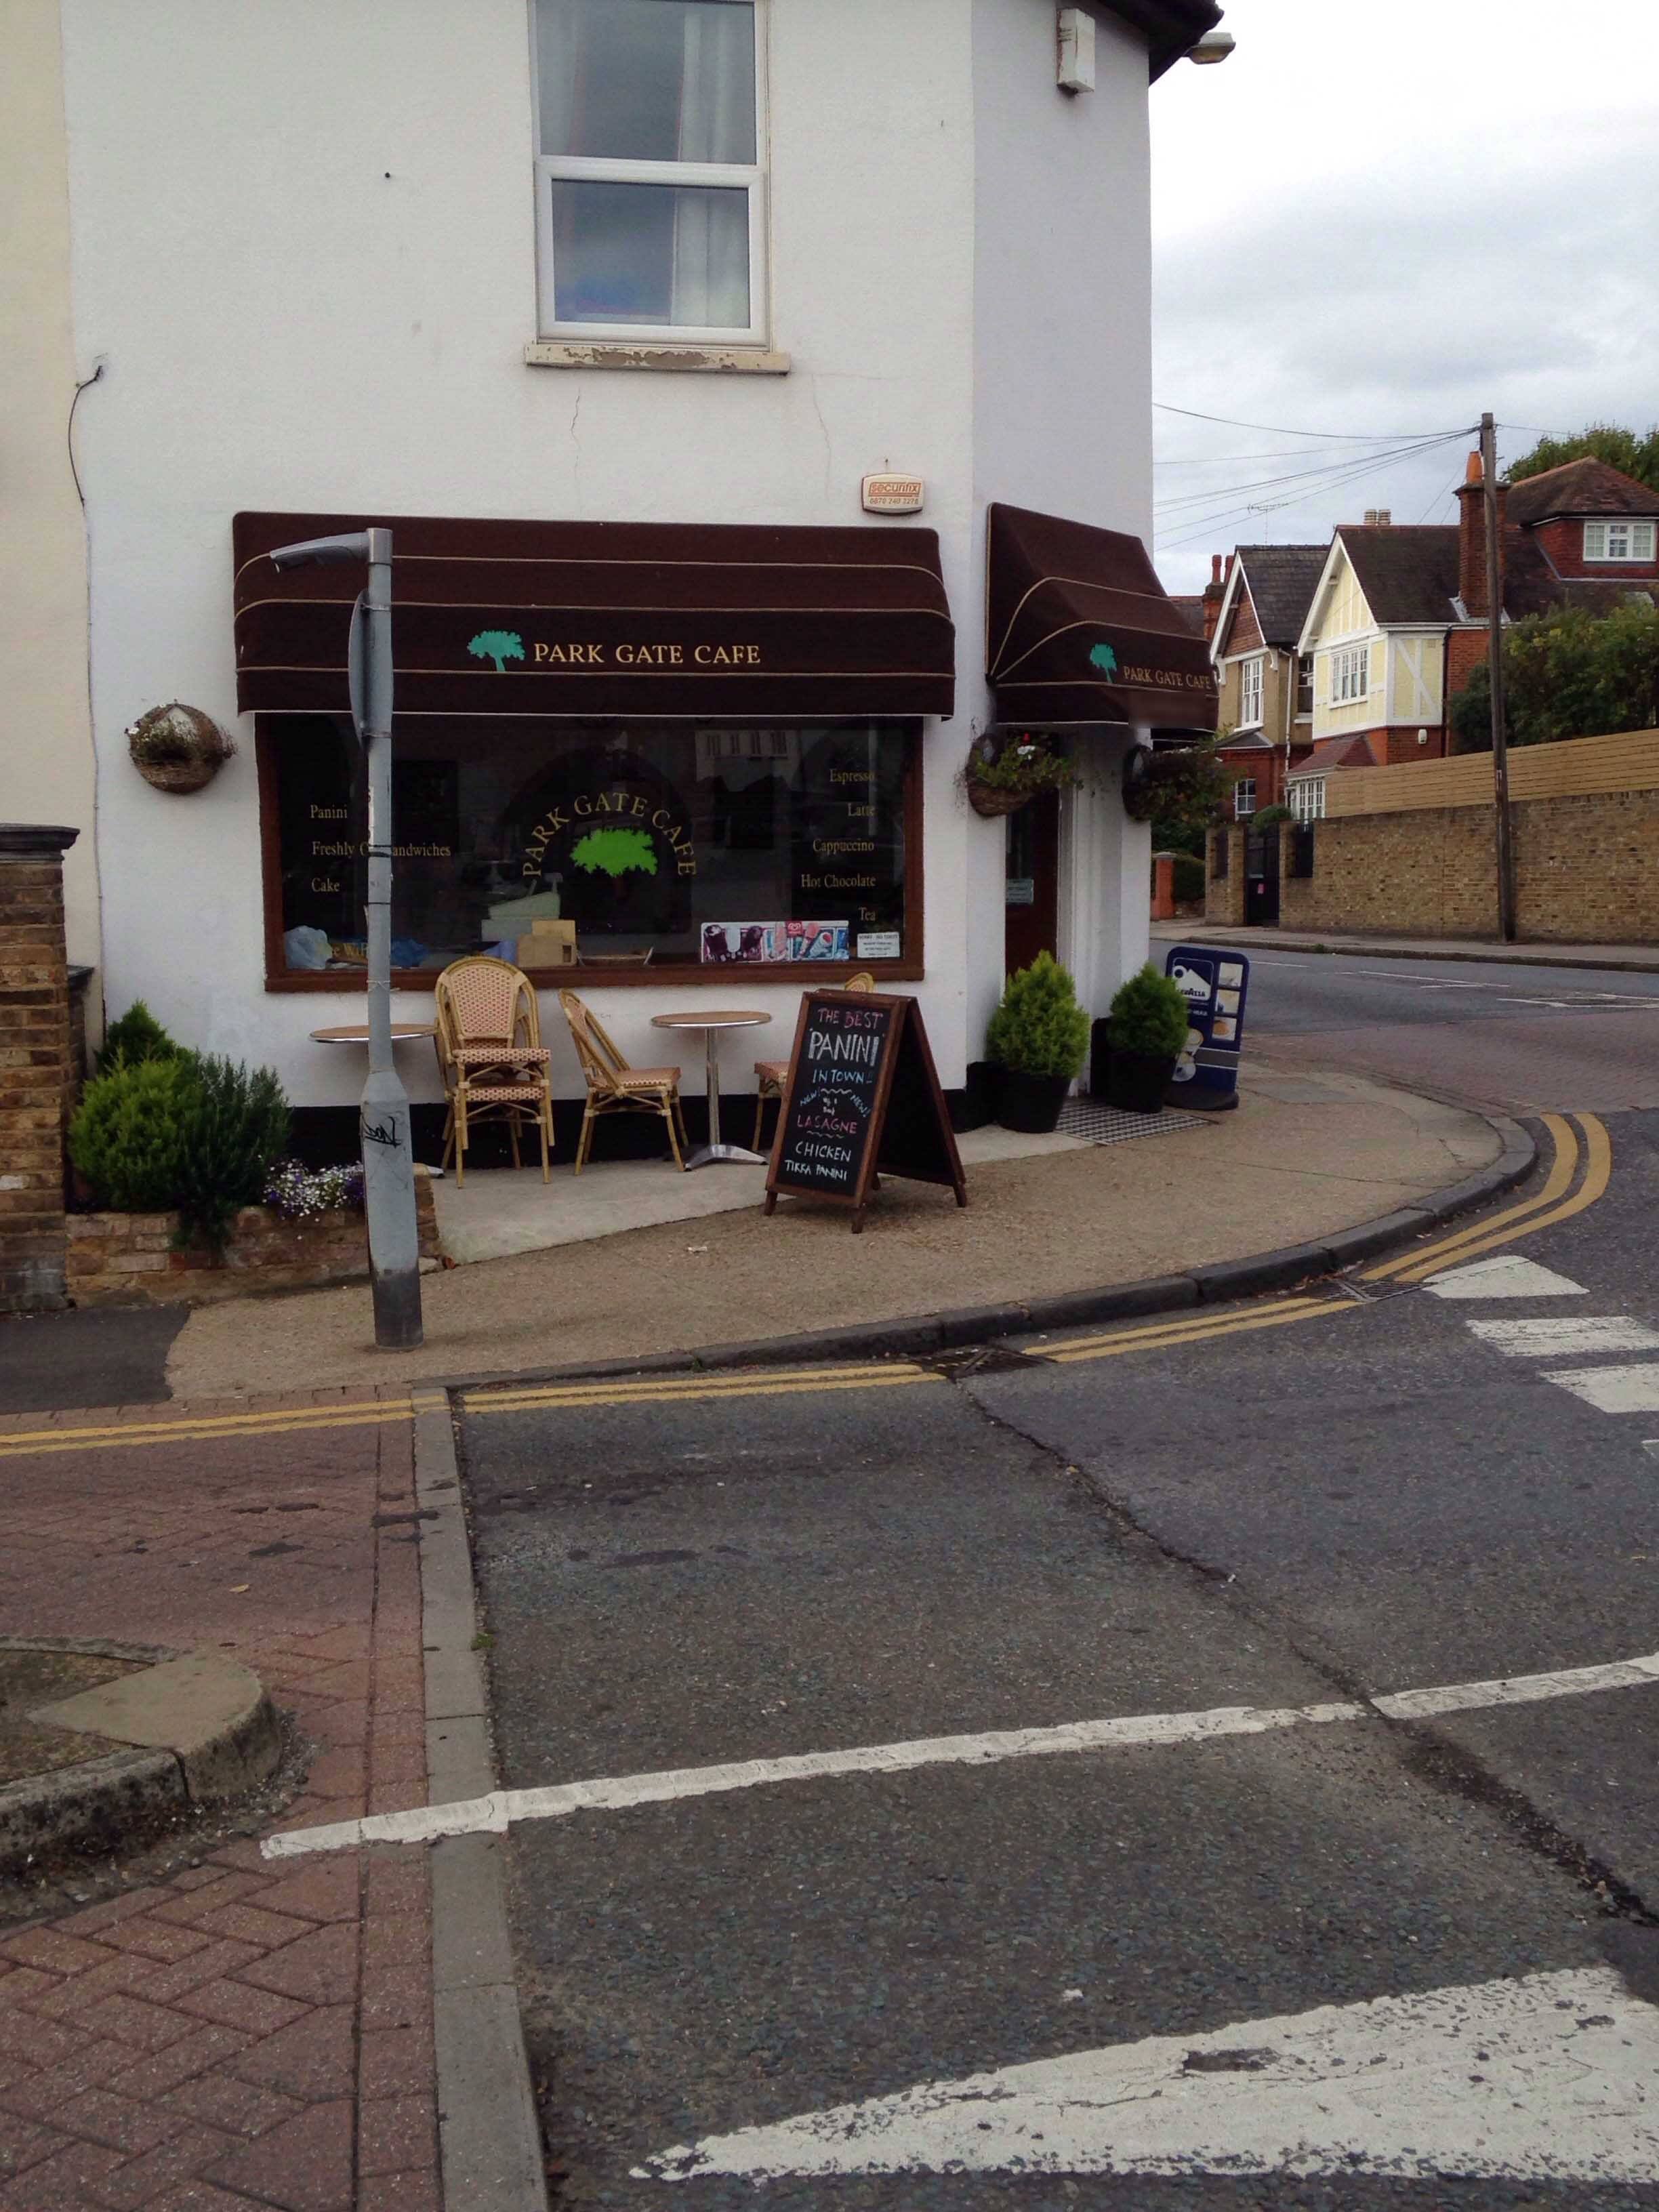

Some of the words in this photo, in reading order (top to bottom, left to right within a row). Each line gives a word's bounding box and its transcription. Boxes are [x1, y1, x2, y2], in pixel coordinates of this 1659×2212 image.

[533, 643, 605, 663] PARK
[615, 644, 684, 664] GATE
[694, 644, 761, 664] CAFE
[1123, 665, 1153, 683] PARK
[1155, 670, 1183, 687] GATE
[1186, 674, 1212, 689] CAFE
[829, 769, 876, 785] Espresso
[310, 804, 348, 819] Panini
[847, 802, 876, 817] Latte
[522, 806, 571, 877] PARK
[573, 792, 649, 818] GATE
[651, 809, 697, 876] CAFE
[312, 840, 355, 859] Freshly
[392, 842, 451, 857] andwiches
[813, 838, 875, 855] Cappuccino
[311, 878, 341, 893] Cake
[800, 874, 821, 888] Hot
[823, 873, 877, 888] Chocolate
[858, 906, 876, 922] Tea
[817, 1007, 840, 1025] THE
[844, 1012, 884, 1029] BEST
[807, 1029, 880, 1067] PANINI
[813, 1069, 828, 1084] IN
[796, 1114, 857, 1134] LASAGNE
[795, 1141, 852, 1162] CHICKEN
[784, 1159, 811, 1176] TIKKA
[815, 1164, 847, 1181] PANINI
